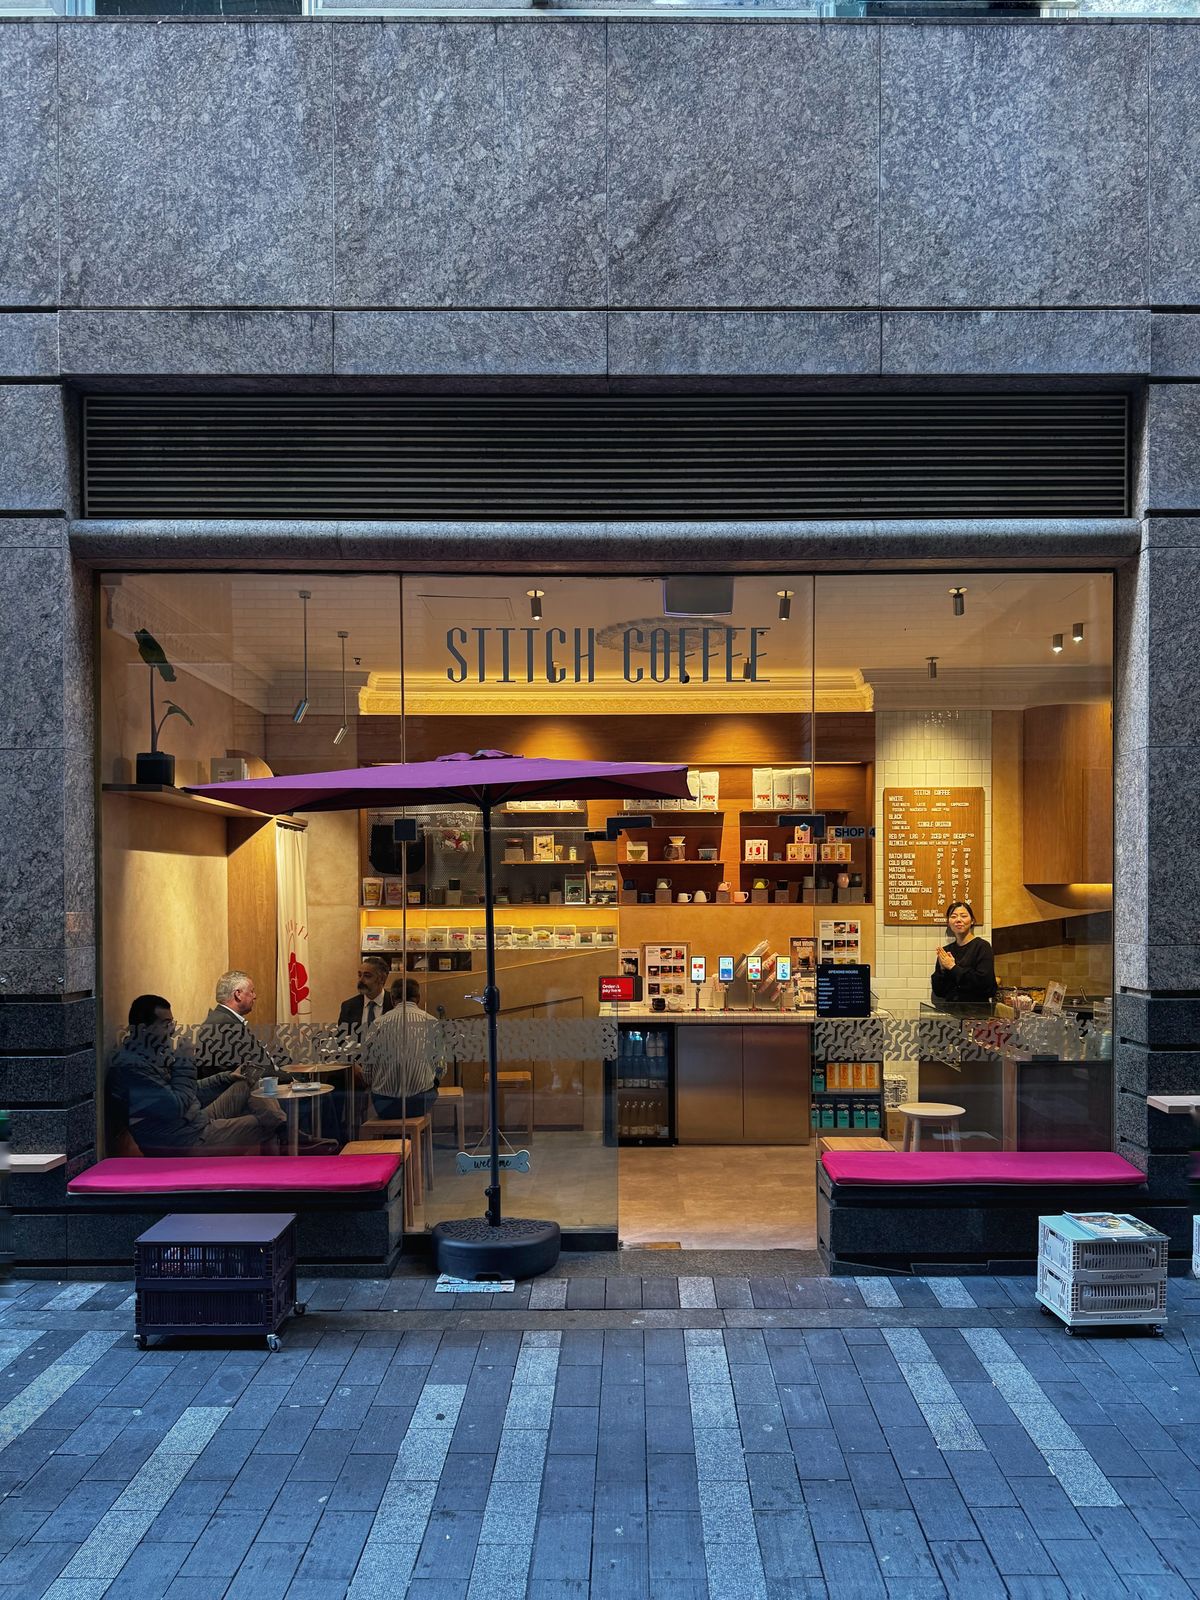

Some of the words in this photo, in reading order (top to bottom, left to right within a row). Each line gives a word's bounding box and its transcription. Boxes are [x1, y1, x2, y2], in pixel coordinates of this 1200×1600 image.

[446, 627, 595, 683] STITCH
[623, 627, 771, 683] COFFEE
[835, 827, 865, 838] SHOP
[473, 1159, 512, 1169] welme
